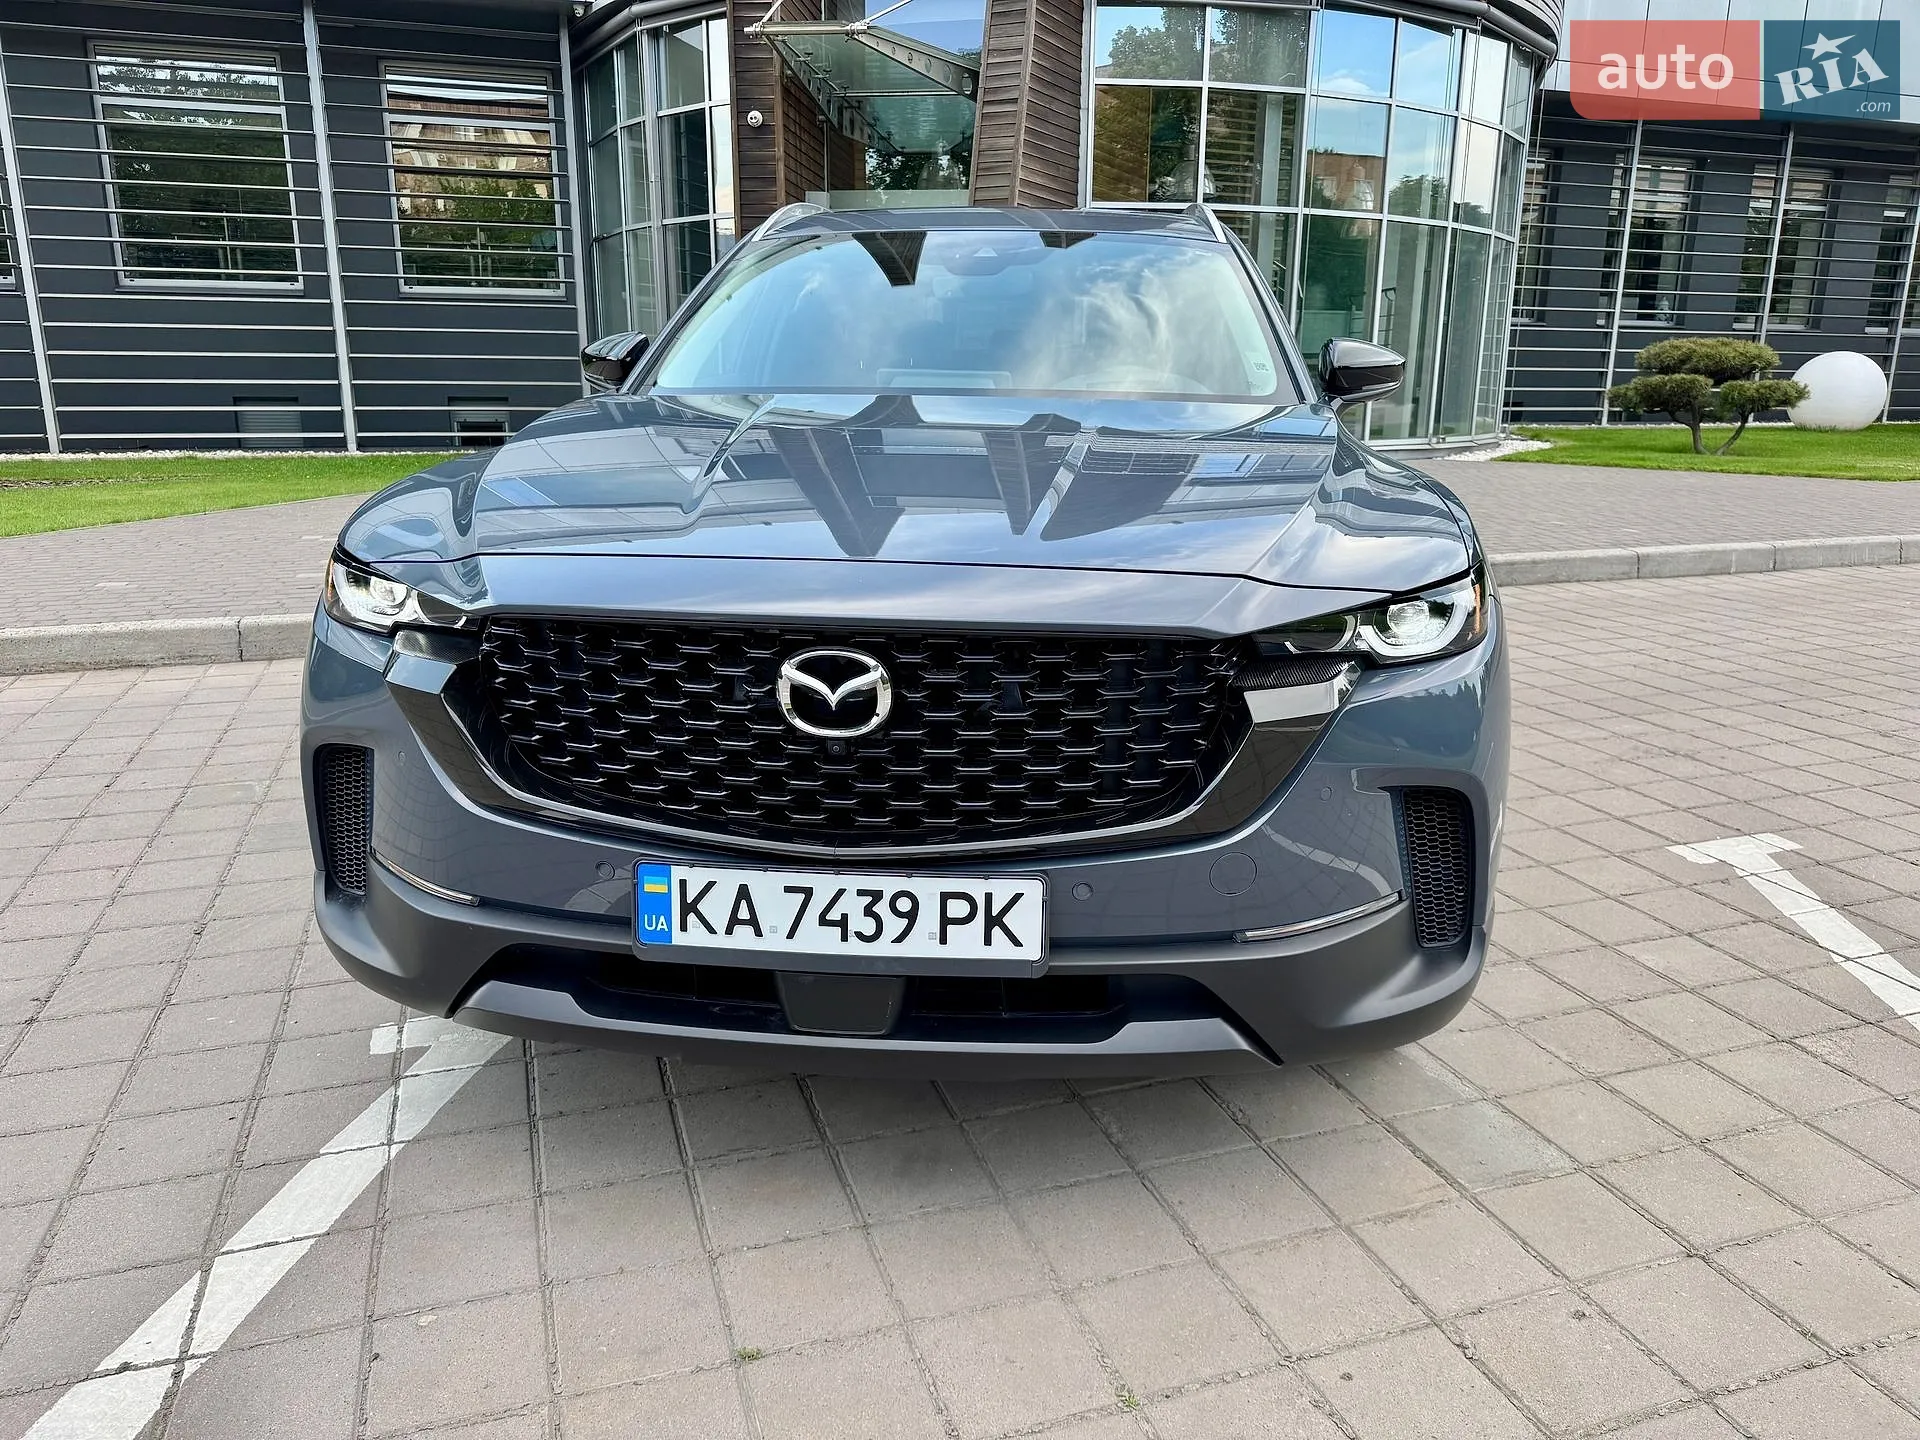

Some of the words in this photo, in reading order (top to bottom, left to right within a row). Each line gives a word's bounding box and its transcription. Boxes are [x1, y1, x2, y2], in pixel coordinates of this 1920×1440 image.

[644, 915, 668, 932] UA
[679, 879, 764, 938] KA
[783, 885, 919, 943] 7439
[939, 891, 1025, 947] PK
